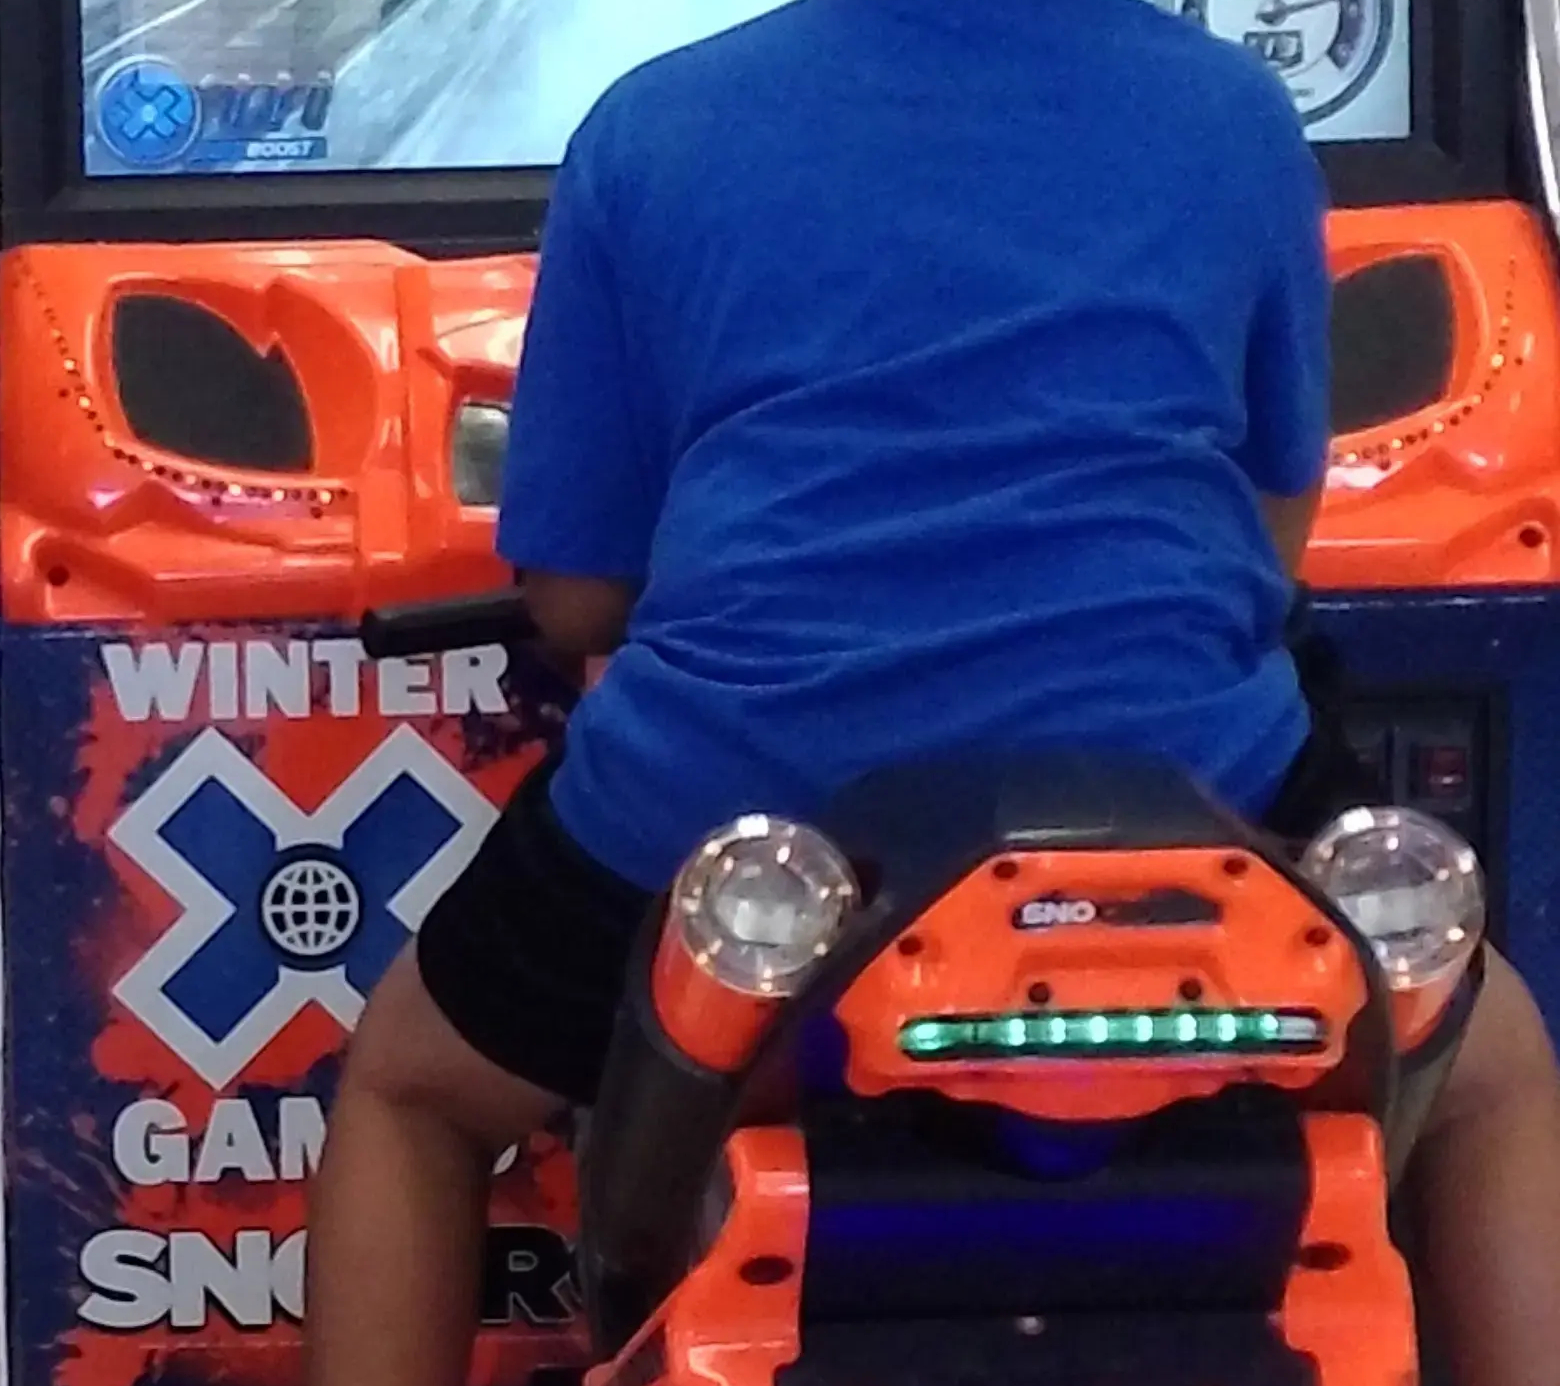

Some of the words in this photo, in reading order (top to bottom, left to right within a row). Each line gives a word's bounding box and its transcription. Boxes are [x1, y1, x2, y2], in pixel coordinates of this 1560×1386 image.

[246, 140, 313, 158] BOOST
[101, 638, 510, 722] WINTER
[1021, 899, 1097, 925] SNO
